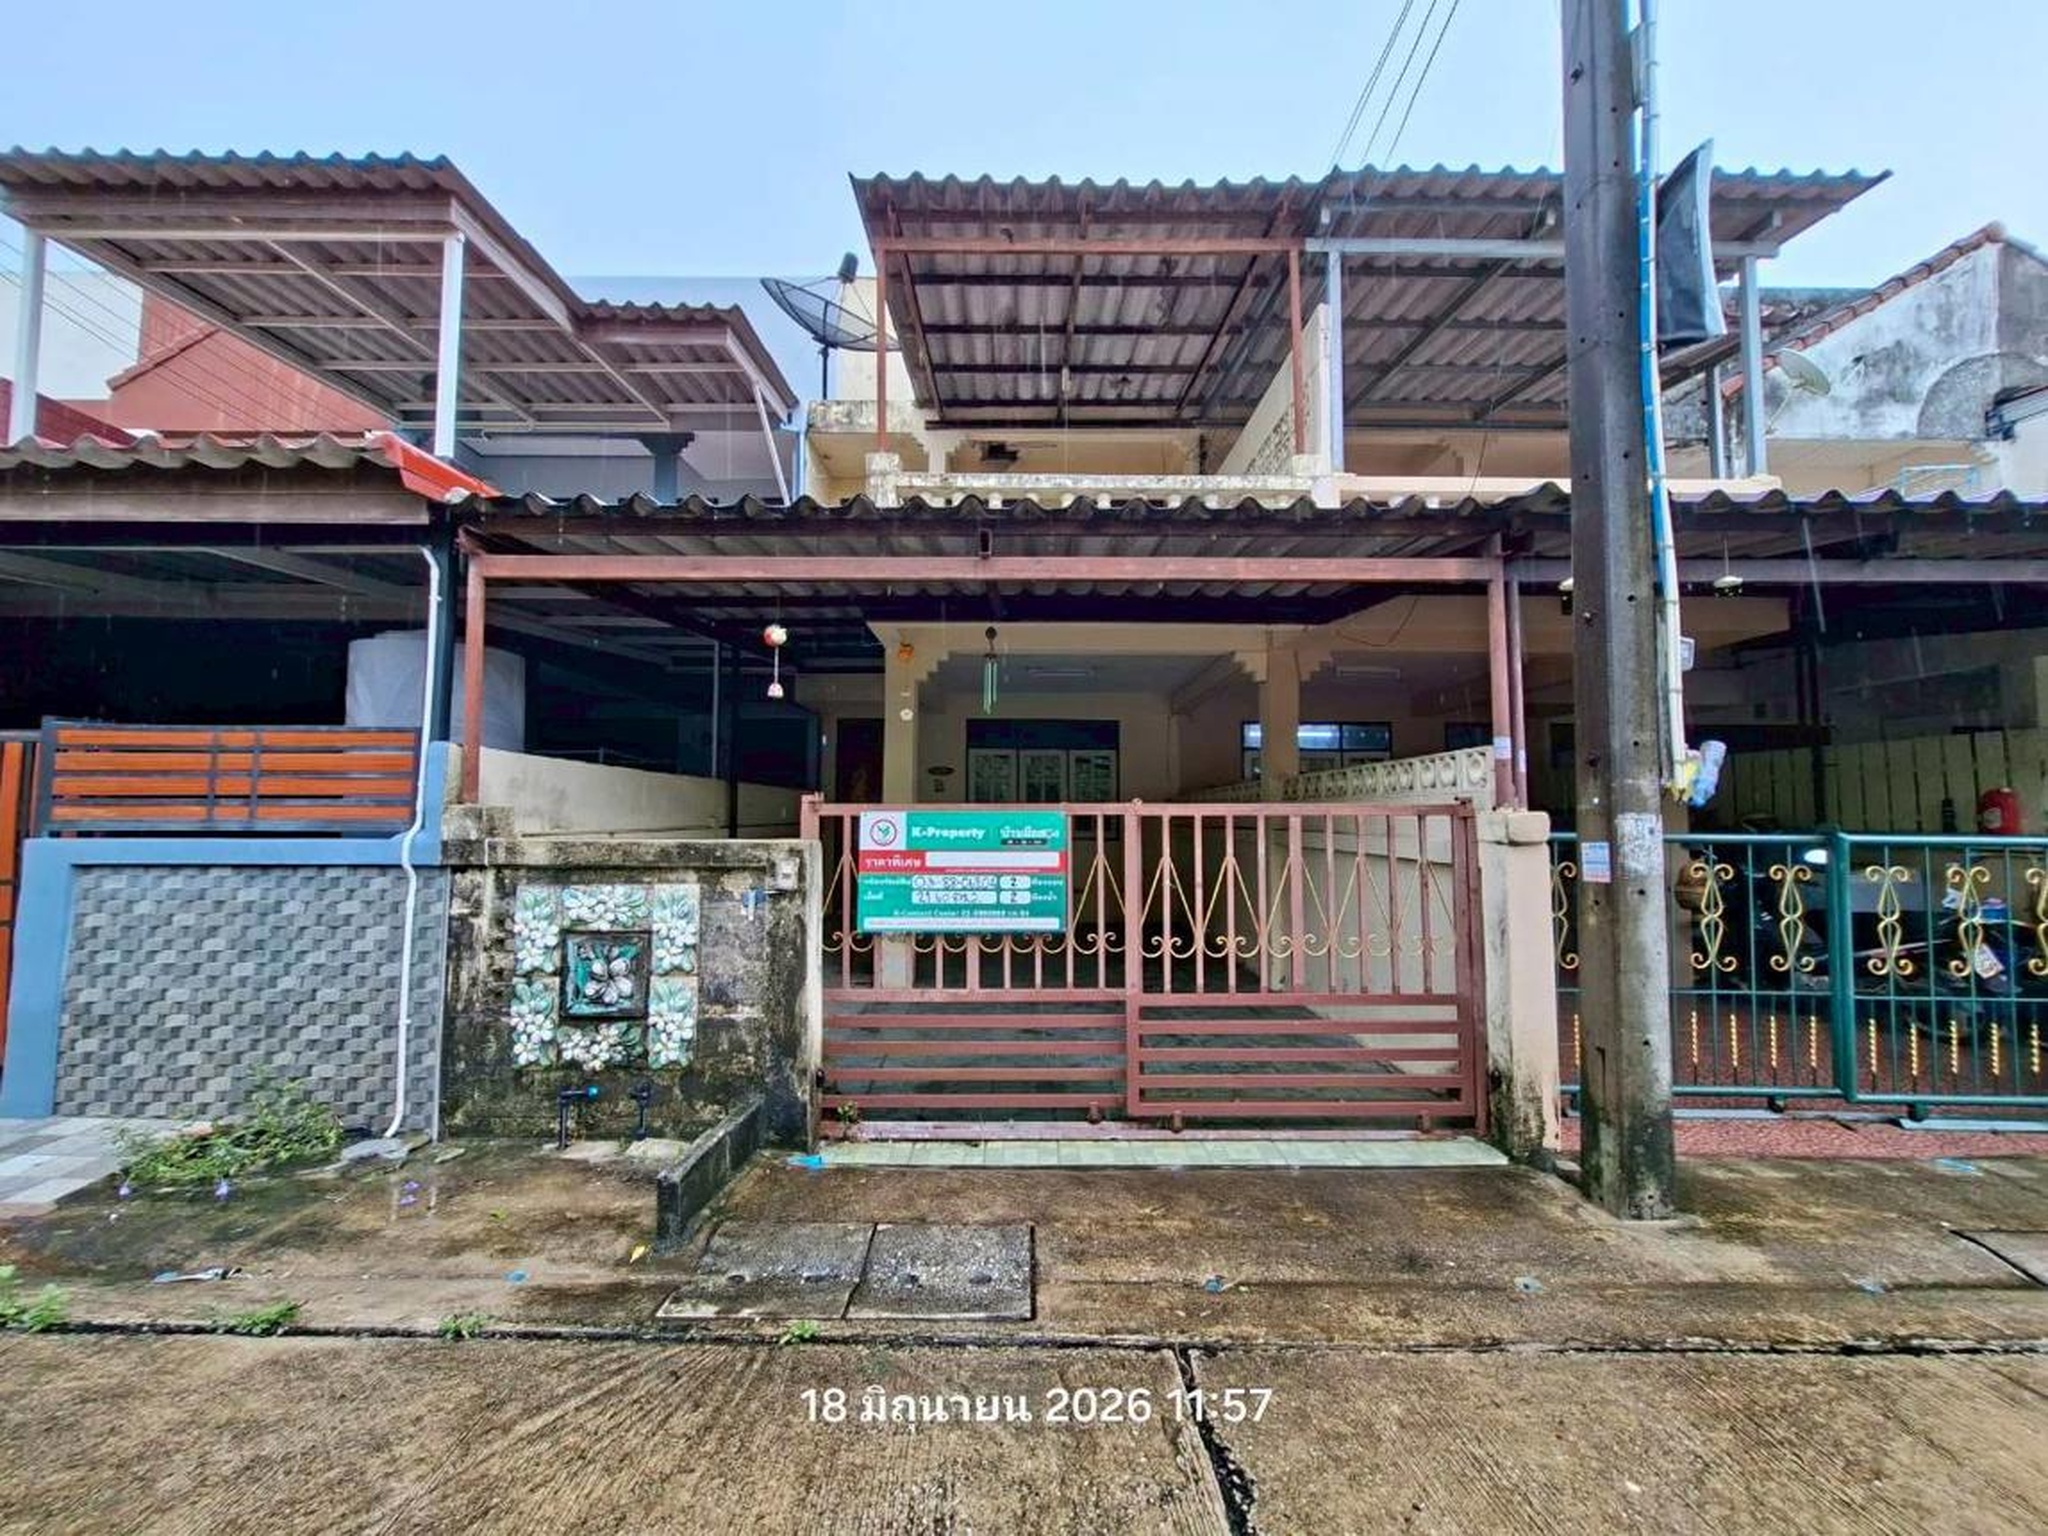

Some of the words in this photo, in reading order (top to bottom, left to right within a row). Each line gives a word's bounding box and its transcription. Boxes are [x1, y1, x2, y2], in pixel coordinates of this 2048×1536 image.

[912, 826, 985, 840] K-Property
[865, 855, 921, 867] ราคาพิเศษ
